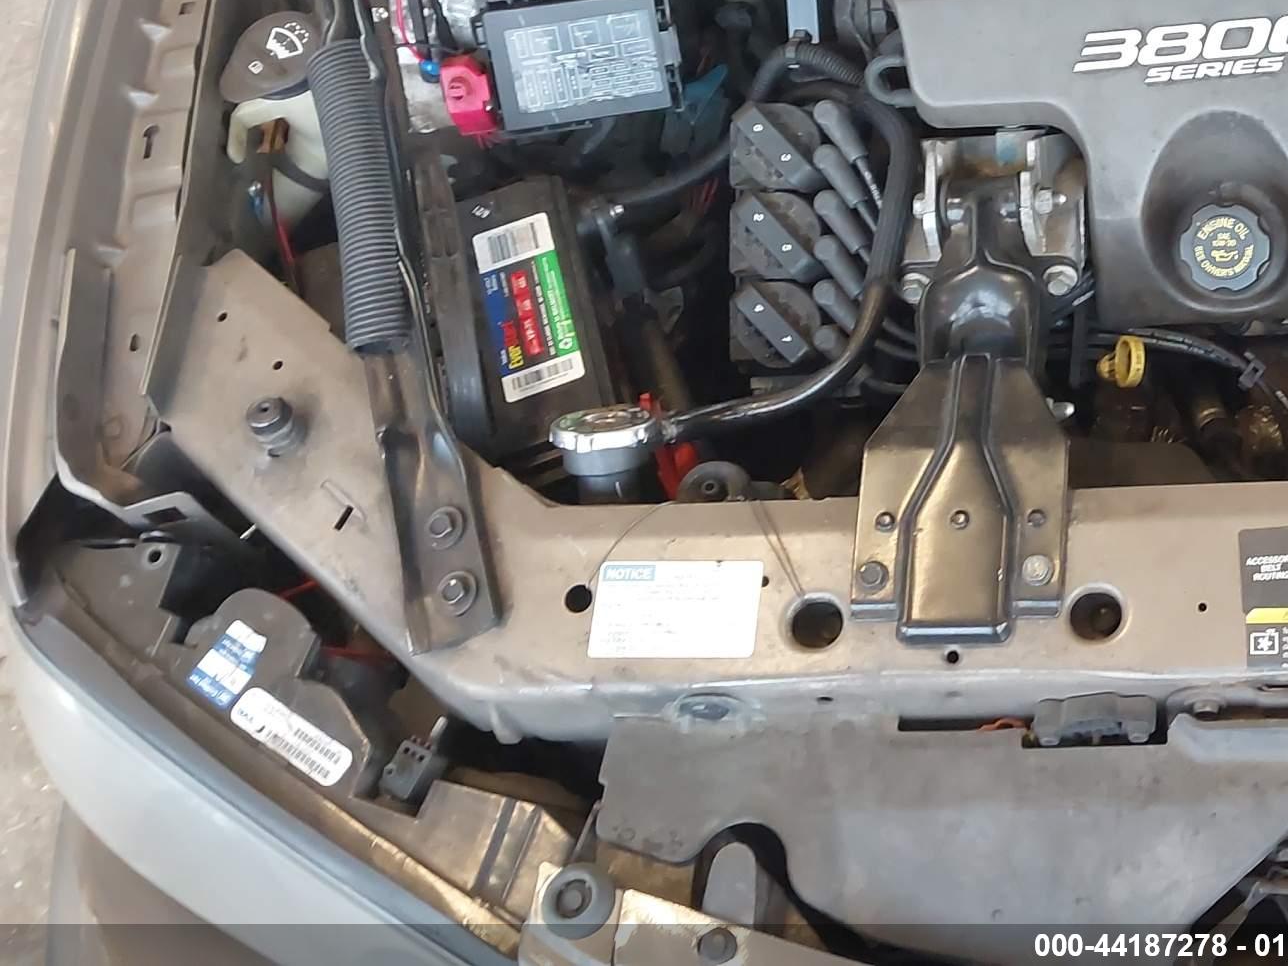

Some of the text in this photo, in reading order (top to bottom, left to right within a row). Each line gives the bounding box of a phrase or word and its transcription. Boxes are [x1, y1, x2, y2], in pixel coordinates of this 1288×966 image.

[1144, 56, 1285, 83] SERIES
[1196, 217, 1250, 240] ENGINE OIL
[606, 567, 654, 580] NOTICE
